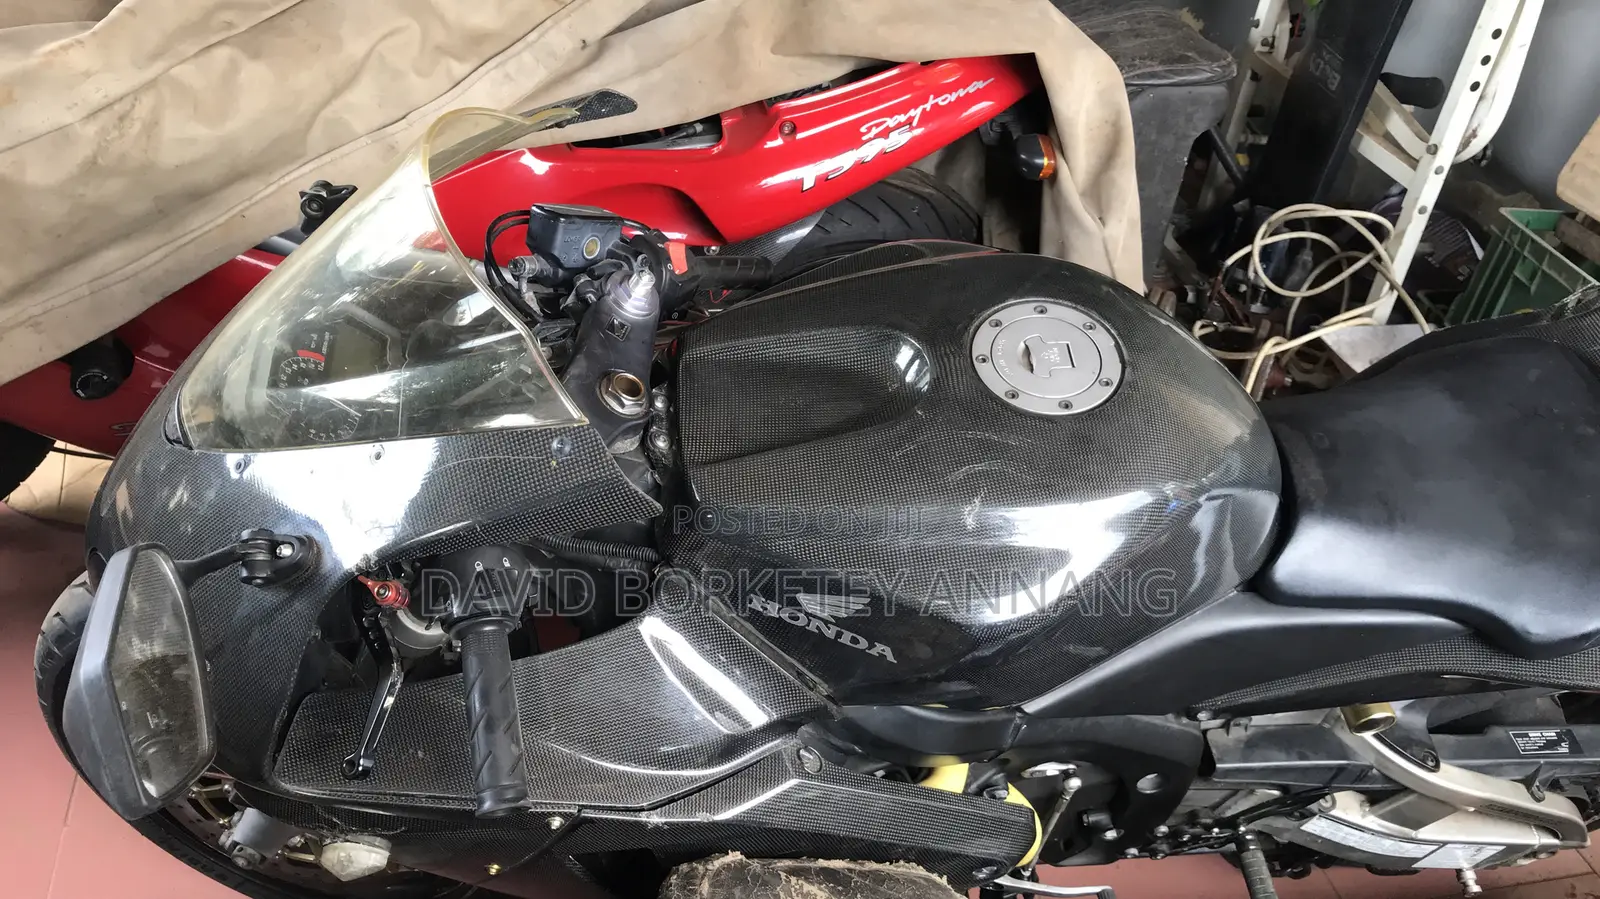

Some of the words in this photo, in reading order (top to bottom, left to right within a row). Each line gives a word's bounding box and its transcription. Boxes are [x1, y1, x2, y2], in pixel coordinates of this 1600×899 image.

[859, 77, 995, 141] Daytona
[799, 122, 914, 192] T595
[749, 594, 898, 663] HONDA
